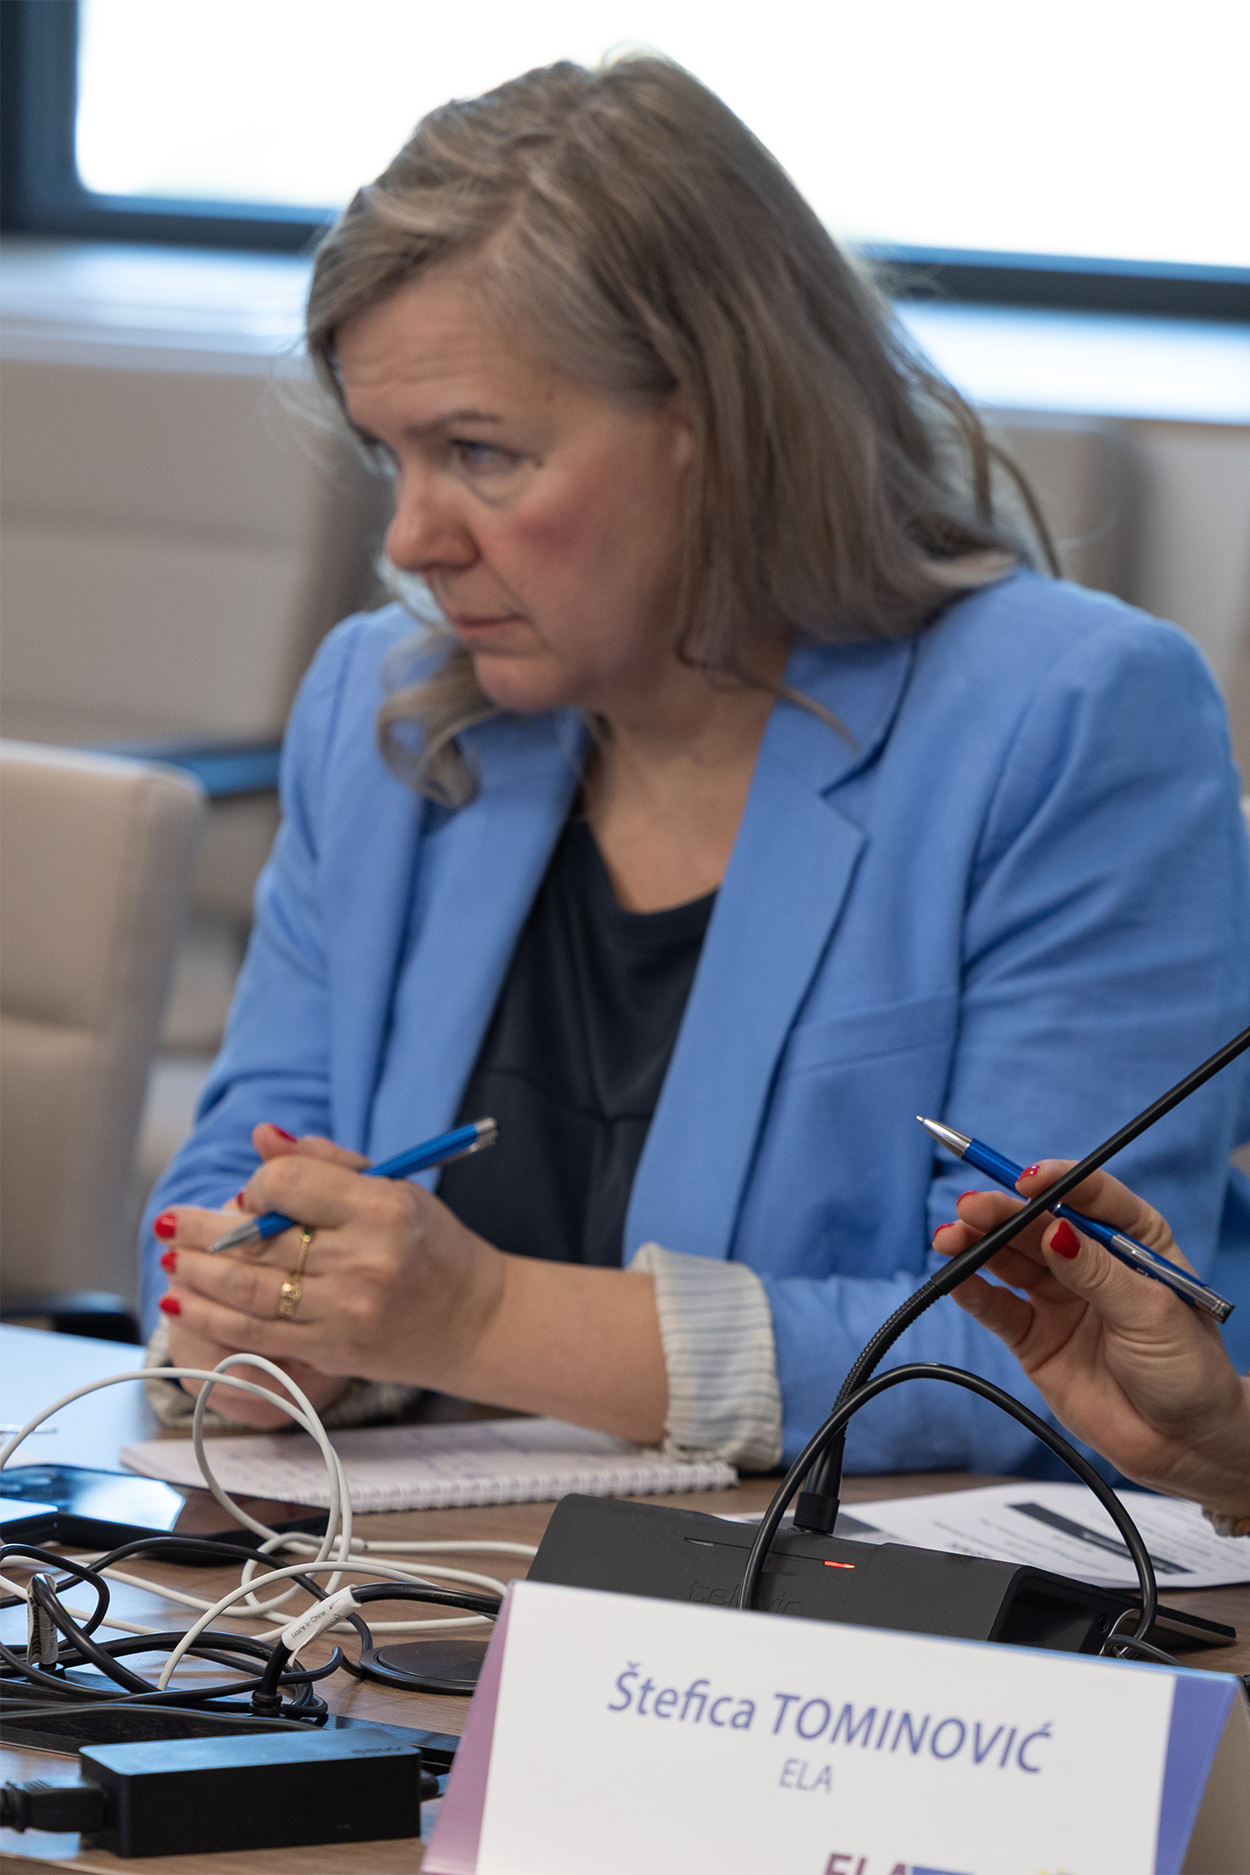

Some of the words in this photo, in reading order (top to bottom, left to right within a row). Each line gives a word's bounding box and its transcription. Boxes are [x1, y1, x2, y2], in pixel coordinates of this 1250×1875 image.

[607, 1661, 757, 1731] Štefica
[772, 1692, 1053, 1775] TOMINOVIĆ
[778, 1757, 833, 1793] ELA
[824, 1853, 907, 1875] EL
